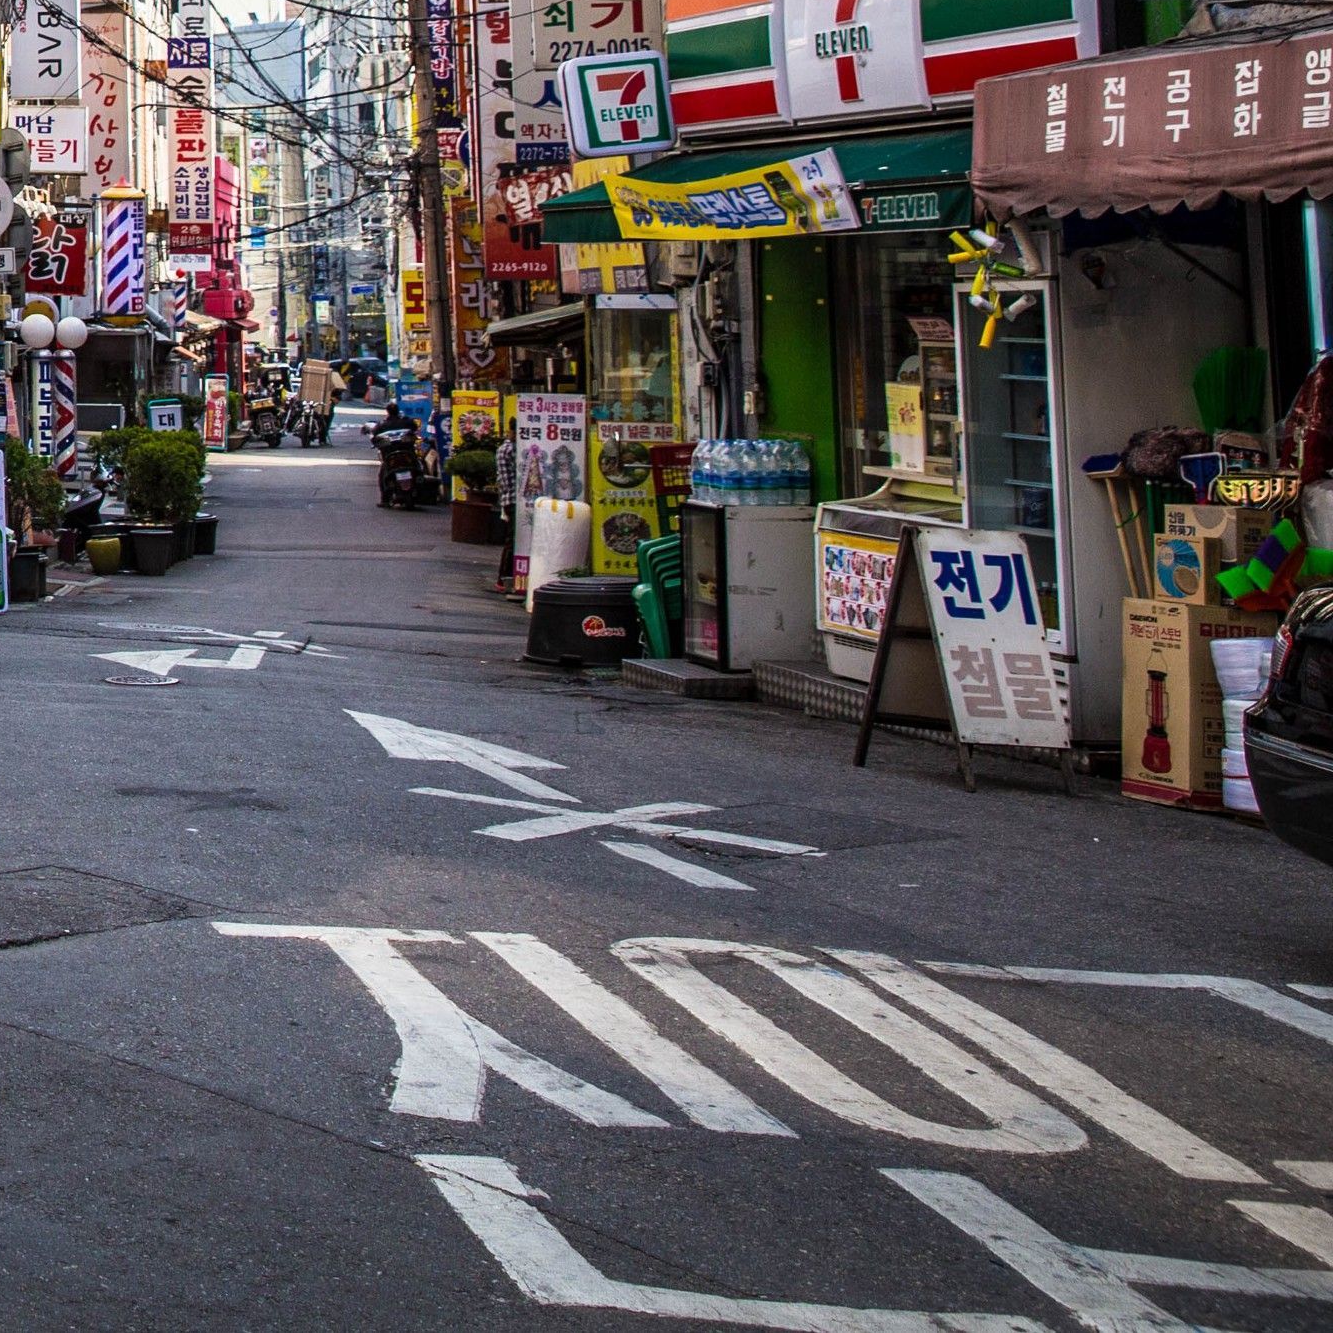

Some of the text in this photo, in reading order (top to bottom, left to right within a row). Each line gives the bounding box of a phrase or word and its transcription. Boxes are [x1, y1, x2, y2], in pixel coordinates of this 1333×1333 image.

[14, 115, 55, 135] 미남
[1044, 82, 1068, 154] 철물
[1101, 75, 1127, 148] 전기
[1164, 69, 1192, 143] 공구
[1233, 59, 1263, 138] 잡화
[518, 427, 542, 441] 전국
[929, 549, 1037, 626] 전기
[949, 643, 1057, 723] 철물
